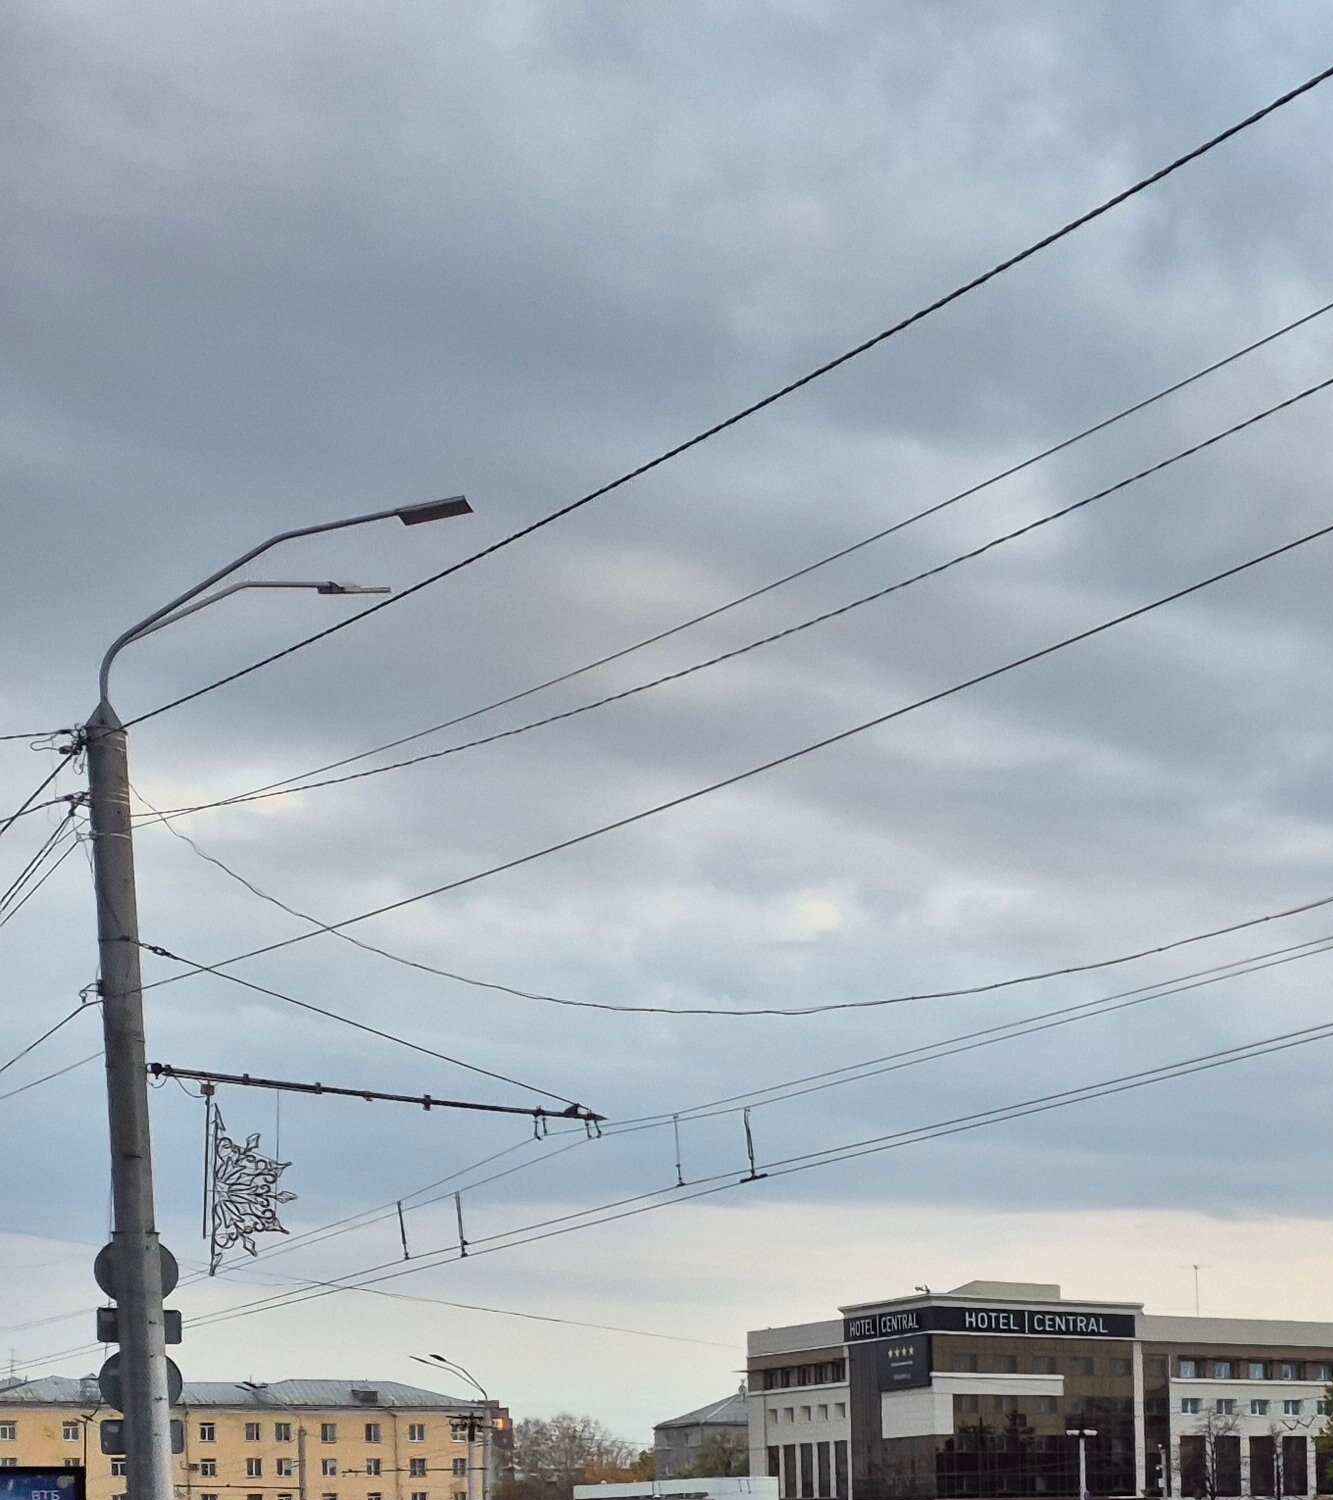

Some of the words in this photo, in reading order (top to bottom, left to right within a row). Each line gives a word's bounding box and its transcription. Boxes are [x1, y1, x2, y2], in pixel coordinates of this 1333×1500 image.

[849, 1318, 876, 1337] HOTEL
[880, 1312, 919, 1332] CENTRAL
[965, 1311, 1020, 1331] HOTEL
[1033, 1314, 1109, 1334] CENTRAL
